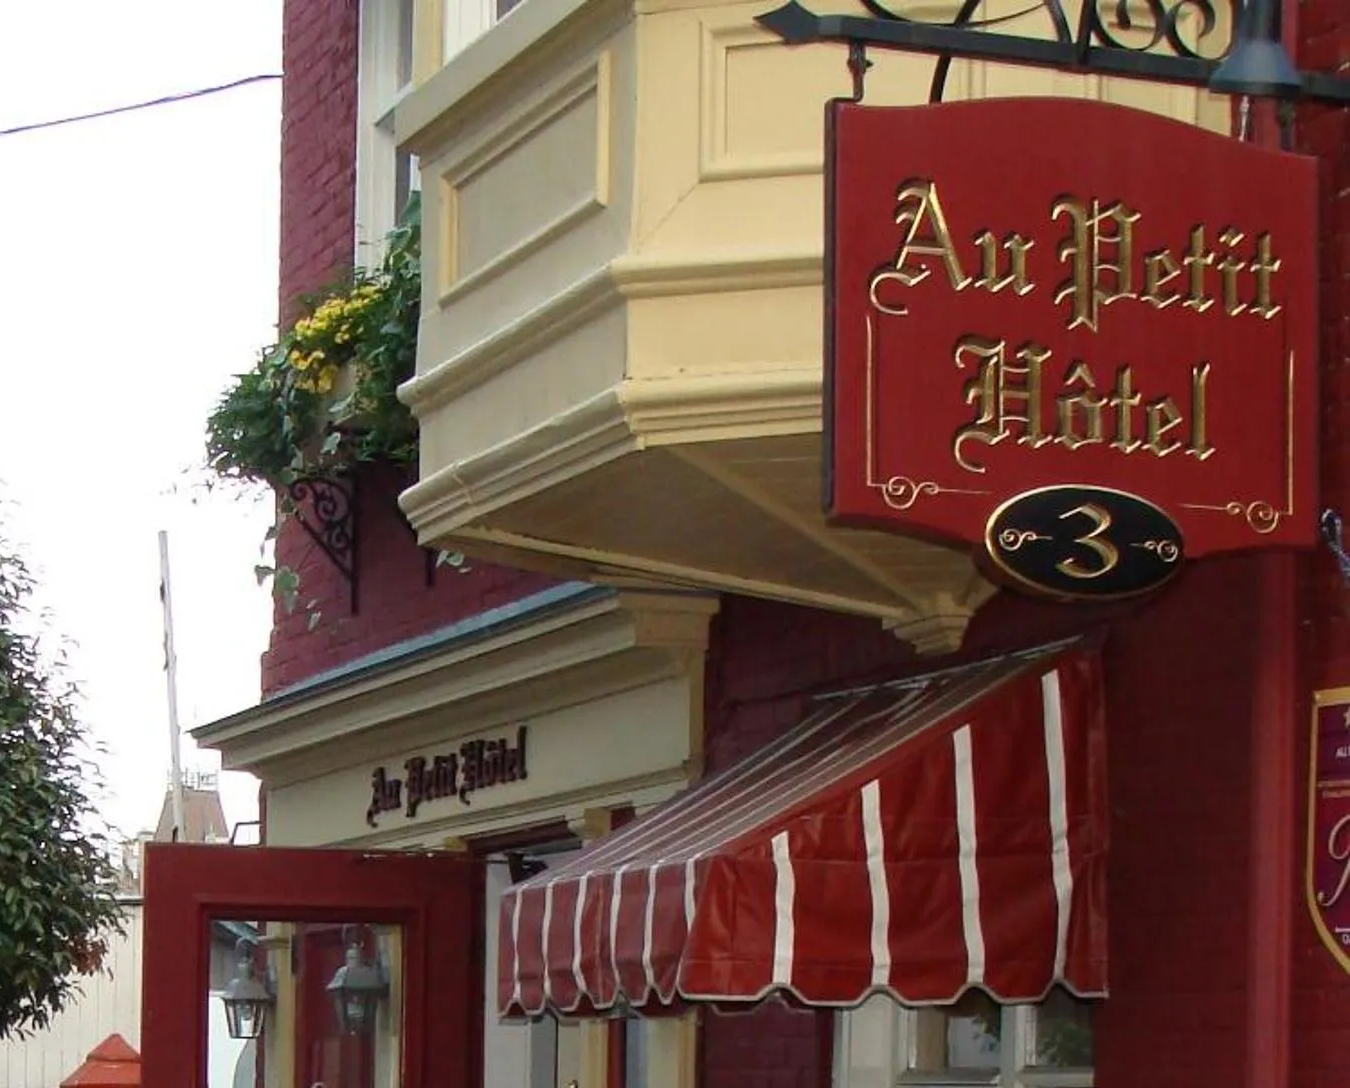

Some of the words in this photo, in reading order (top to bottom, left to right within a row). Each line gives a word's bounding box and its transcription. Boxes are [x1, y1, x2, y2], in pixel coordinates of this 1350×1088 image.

[869, 178, 1036, 315] Au
[1050, 194, 1282, 333] Petit
[953, 334, 1217, 473] Hôtel
[1054, 503, 1118, 579] 3
